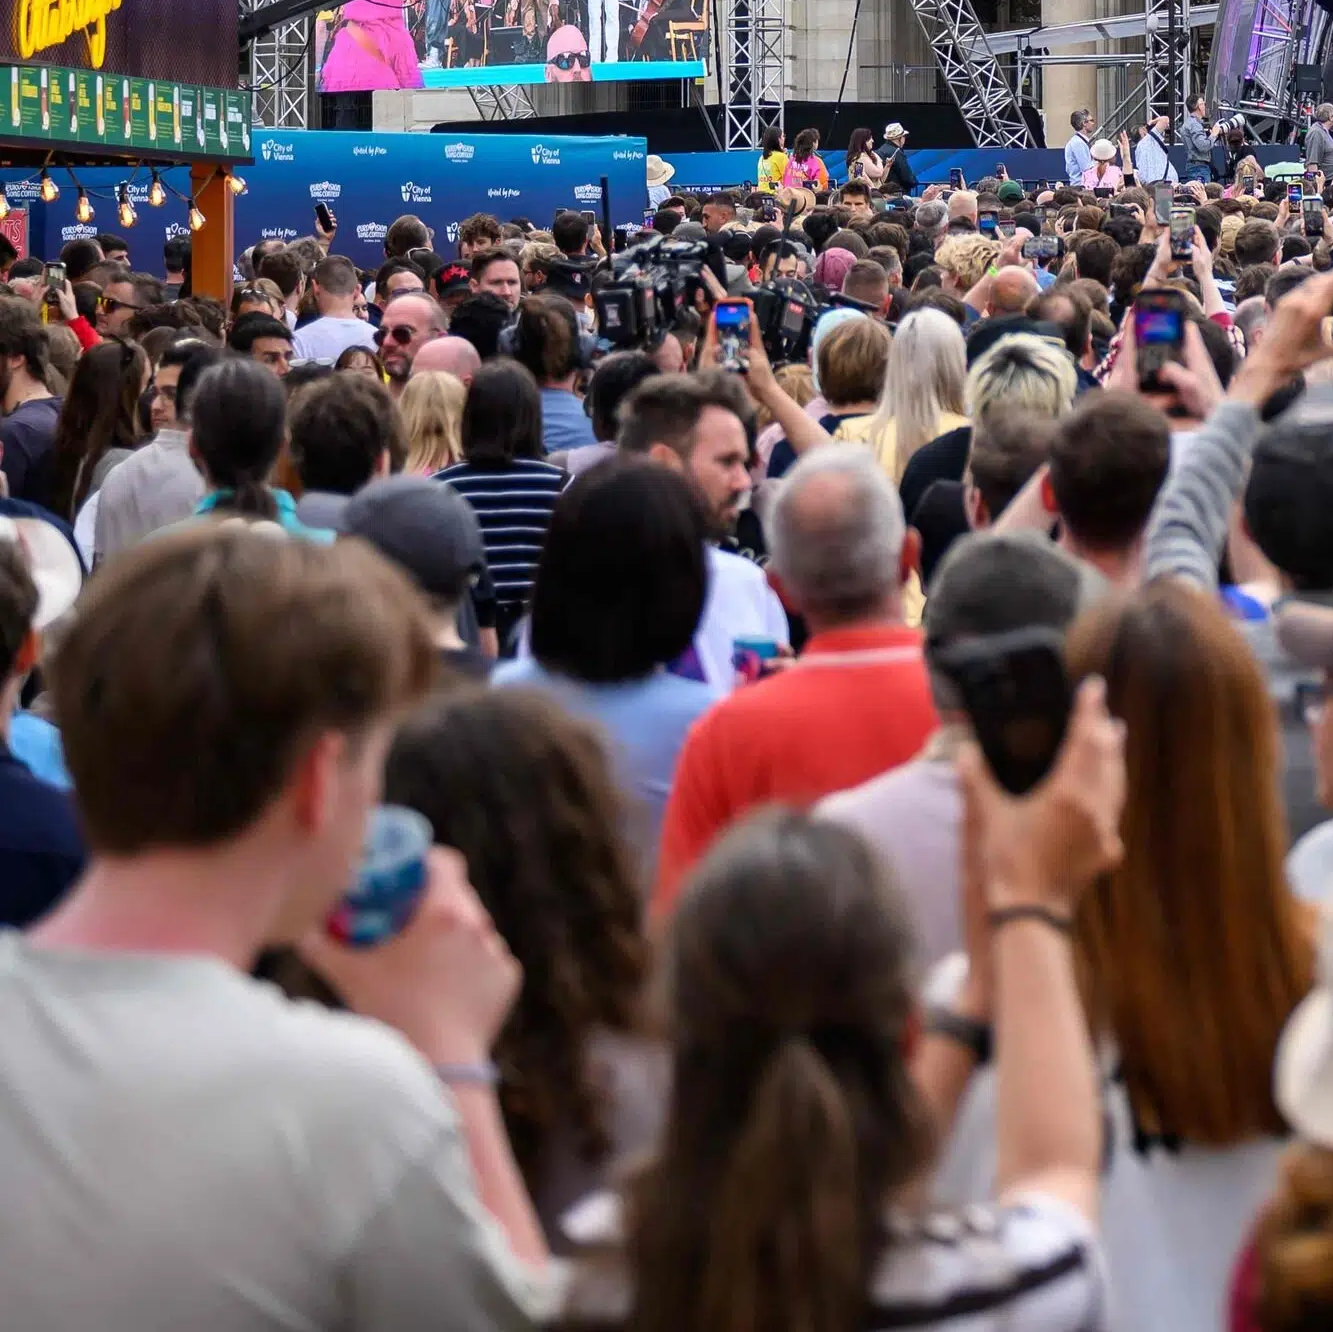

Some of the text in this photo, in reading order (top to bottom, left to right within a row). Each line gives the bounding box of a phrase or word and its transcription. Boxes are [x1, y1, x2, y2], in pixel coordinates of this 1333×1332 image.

[274, 143, 293, 154] City of
[542, 148, 560, 159] City of
[274, 152, 293, 160] Vienna
[542, 156, 560, 164] Vienna
[127, 184, 148, 195] City of
[412, 185, 431, 196] City of
[413, 194, 432, 202] Vienna
